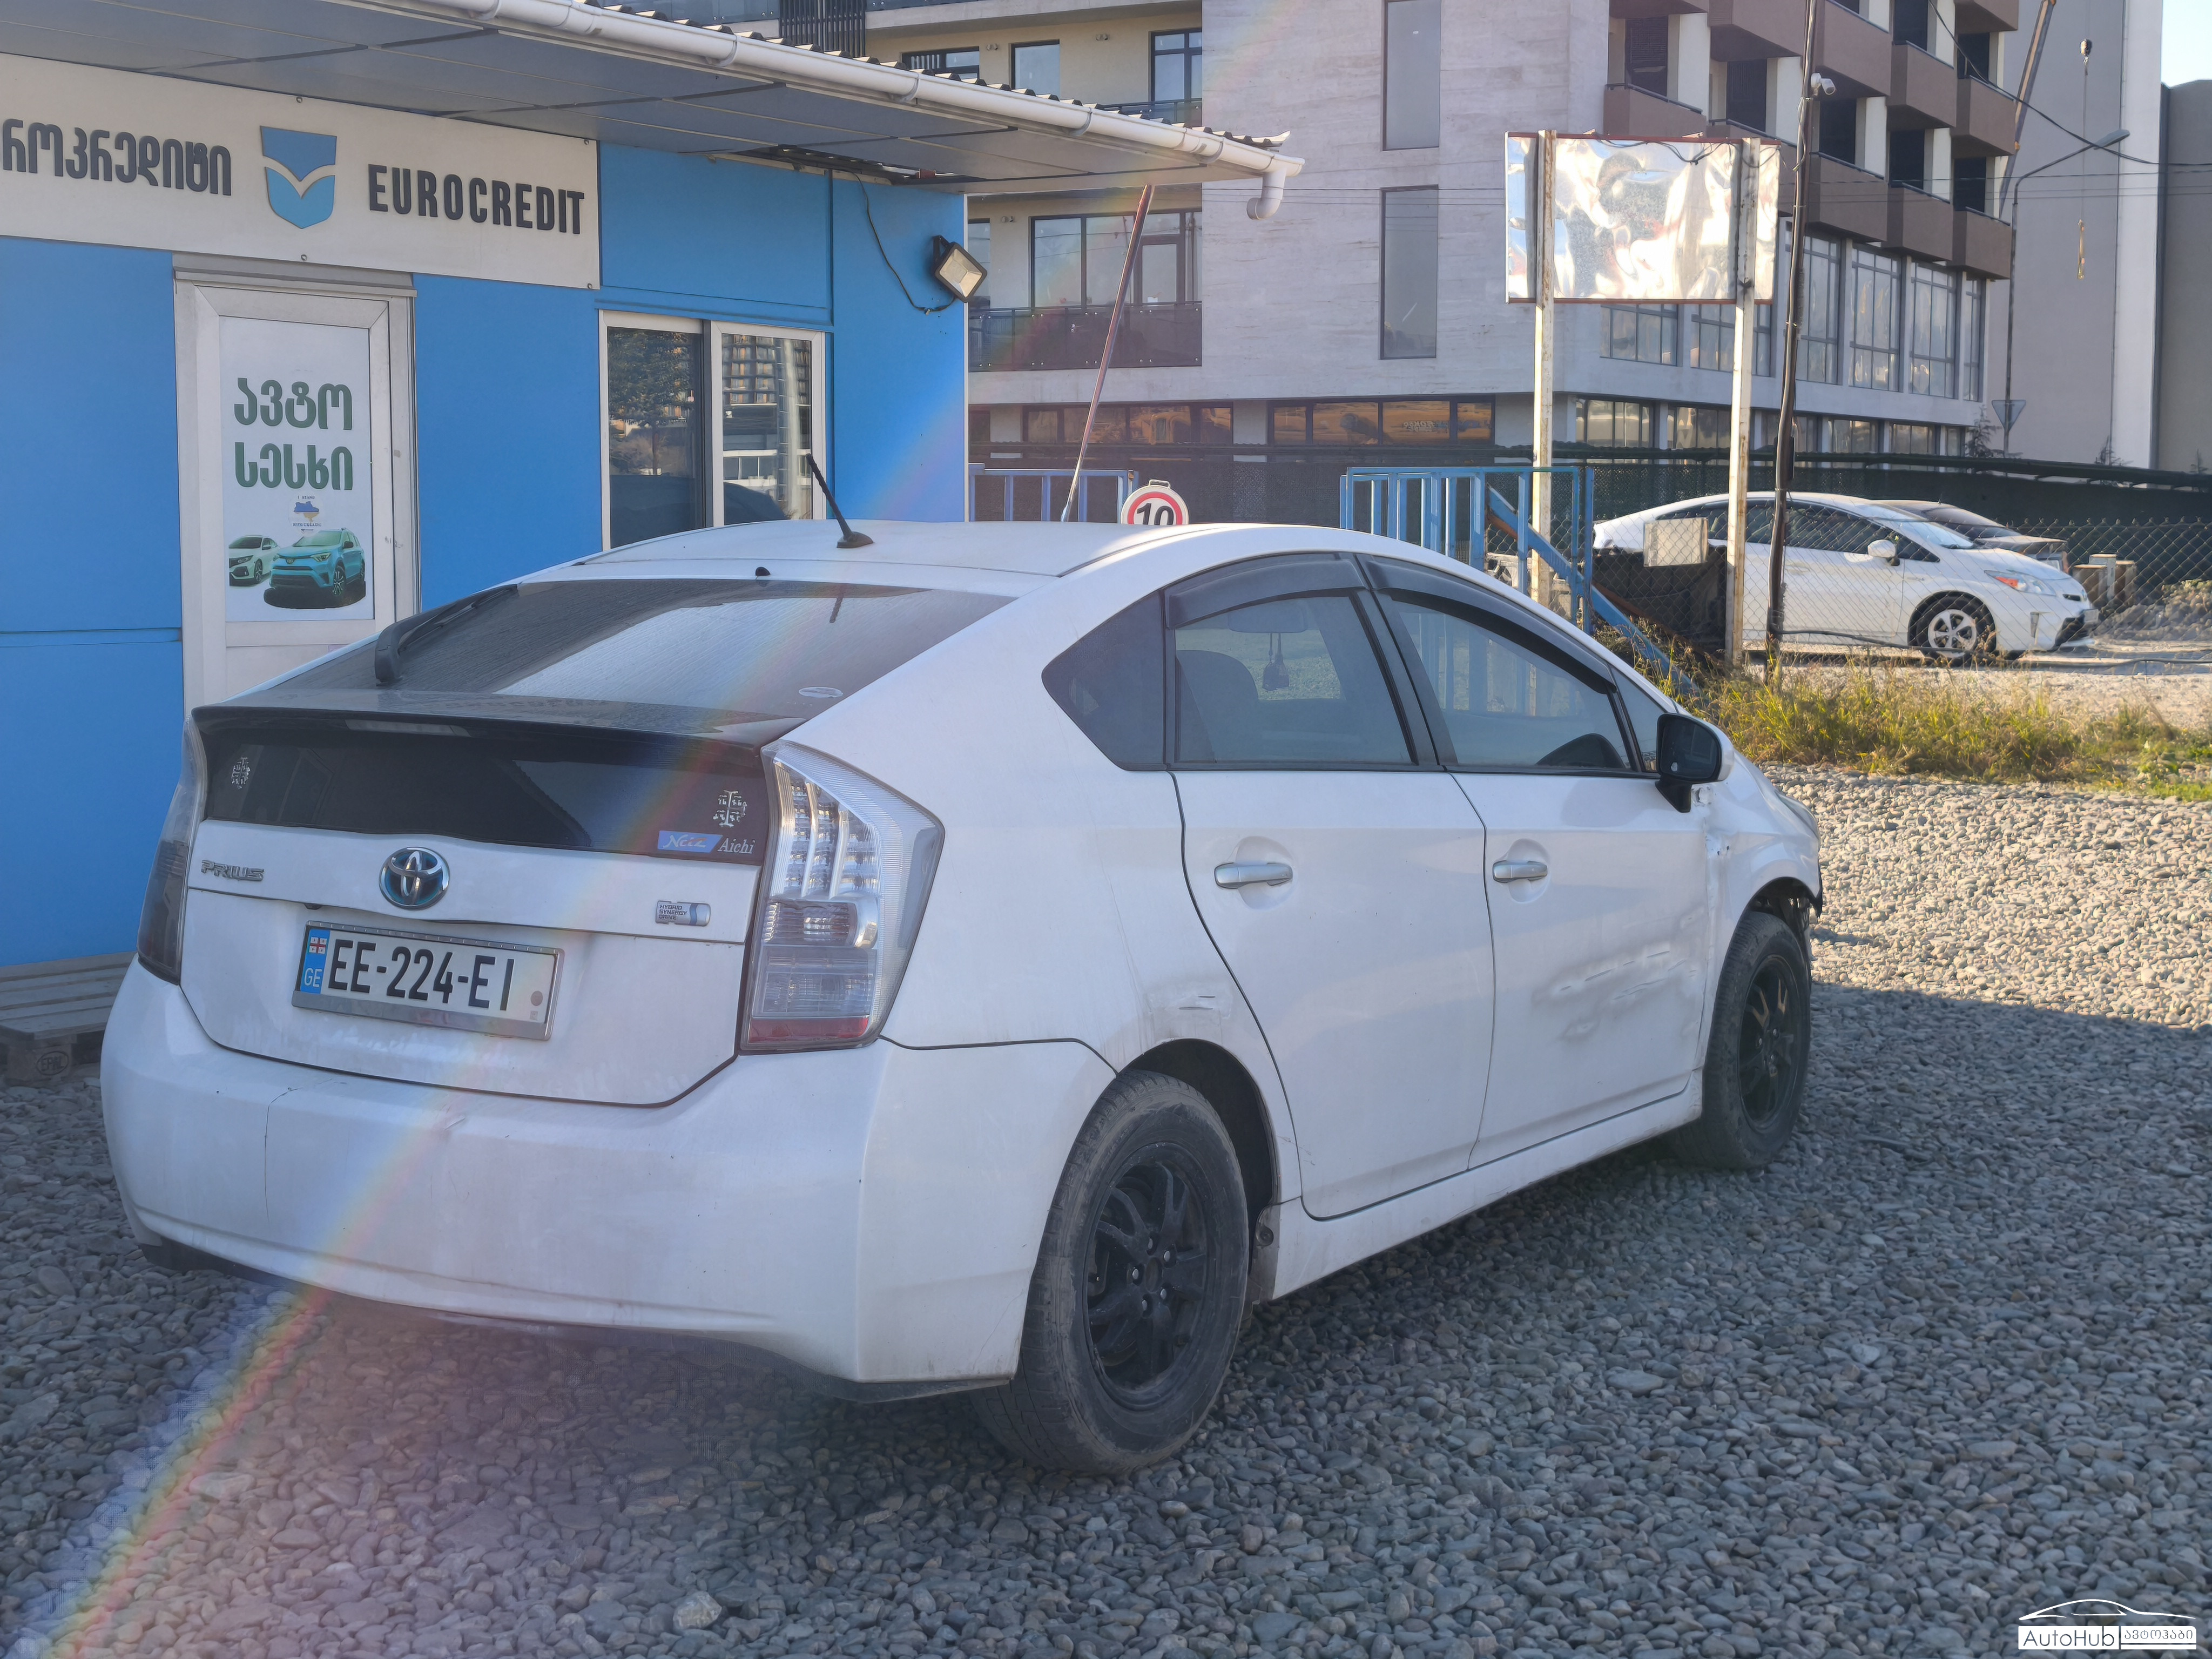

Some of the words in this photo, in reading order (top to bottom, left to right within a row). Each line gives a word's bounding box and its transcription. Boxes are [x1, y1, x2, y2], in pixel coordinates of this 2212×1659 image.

[2, 118, 232, 196] როკრედიტი
[368, 164, 585, 234] EUROCREDIT
[234, 377, 353, 430] ავტო
[234, 441, 353, 490] სესხი
[1137, 503, 1174, 525] 10
[201, 860, 264, 881] PRIUS
[717, 838, 756, 854] Aichi
[304, 967, 322, 988] GE
[328, 939, 515, 1011] EE-224-EI
